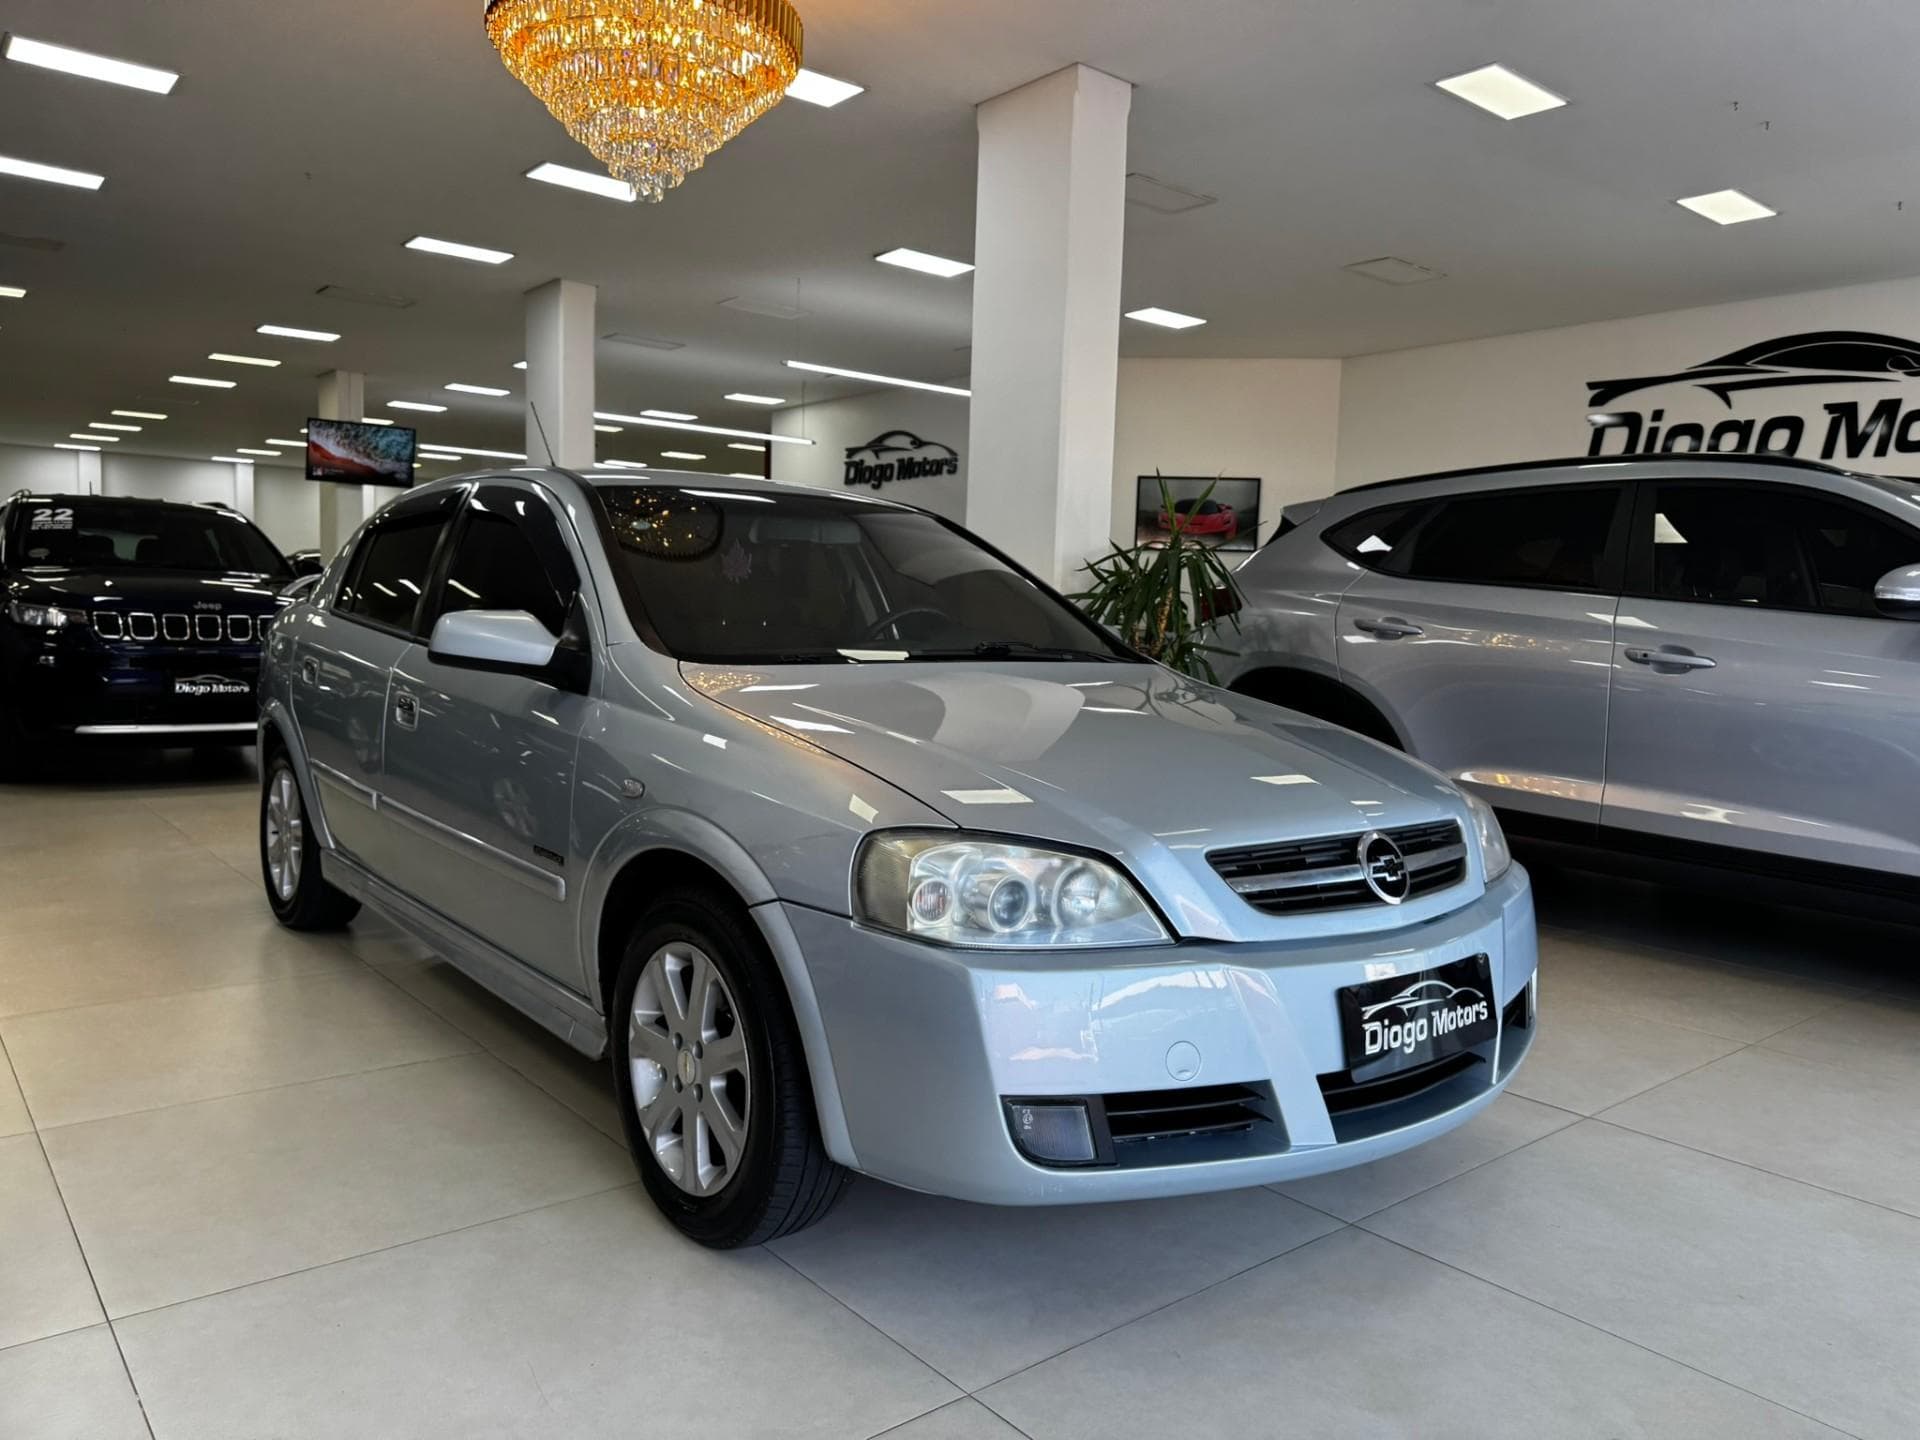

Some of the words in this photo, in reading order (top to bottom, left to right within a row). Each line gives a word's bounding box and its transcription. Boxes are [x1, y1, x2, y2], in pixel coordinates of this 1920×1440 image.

[844, 459, 894, 490] Diogo
[896, 457, 958, 480] Motors
[32, 508, 74, 521] 22
[193, 601, 222, 611] Jeep
[175, 682, 210, 695] Diogo
[211, 683, 250, 694] Motors
[1362, 1018, 1428, 1055] Diogo
[1431, 1000, 1488, 1038] Motors
